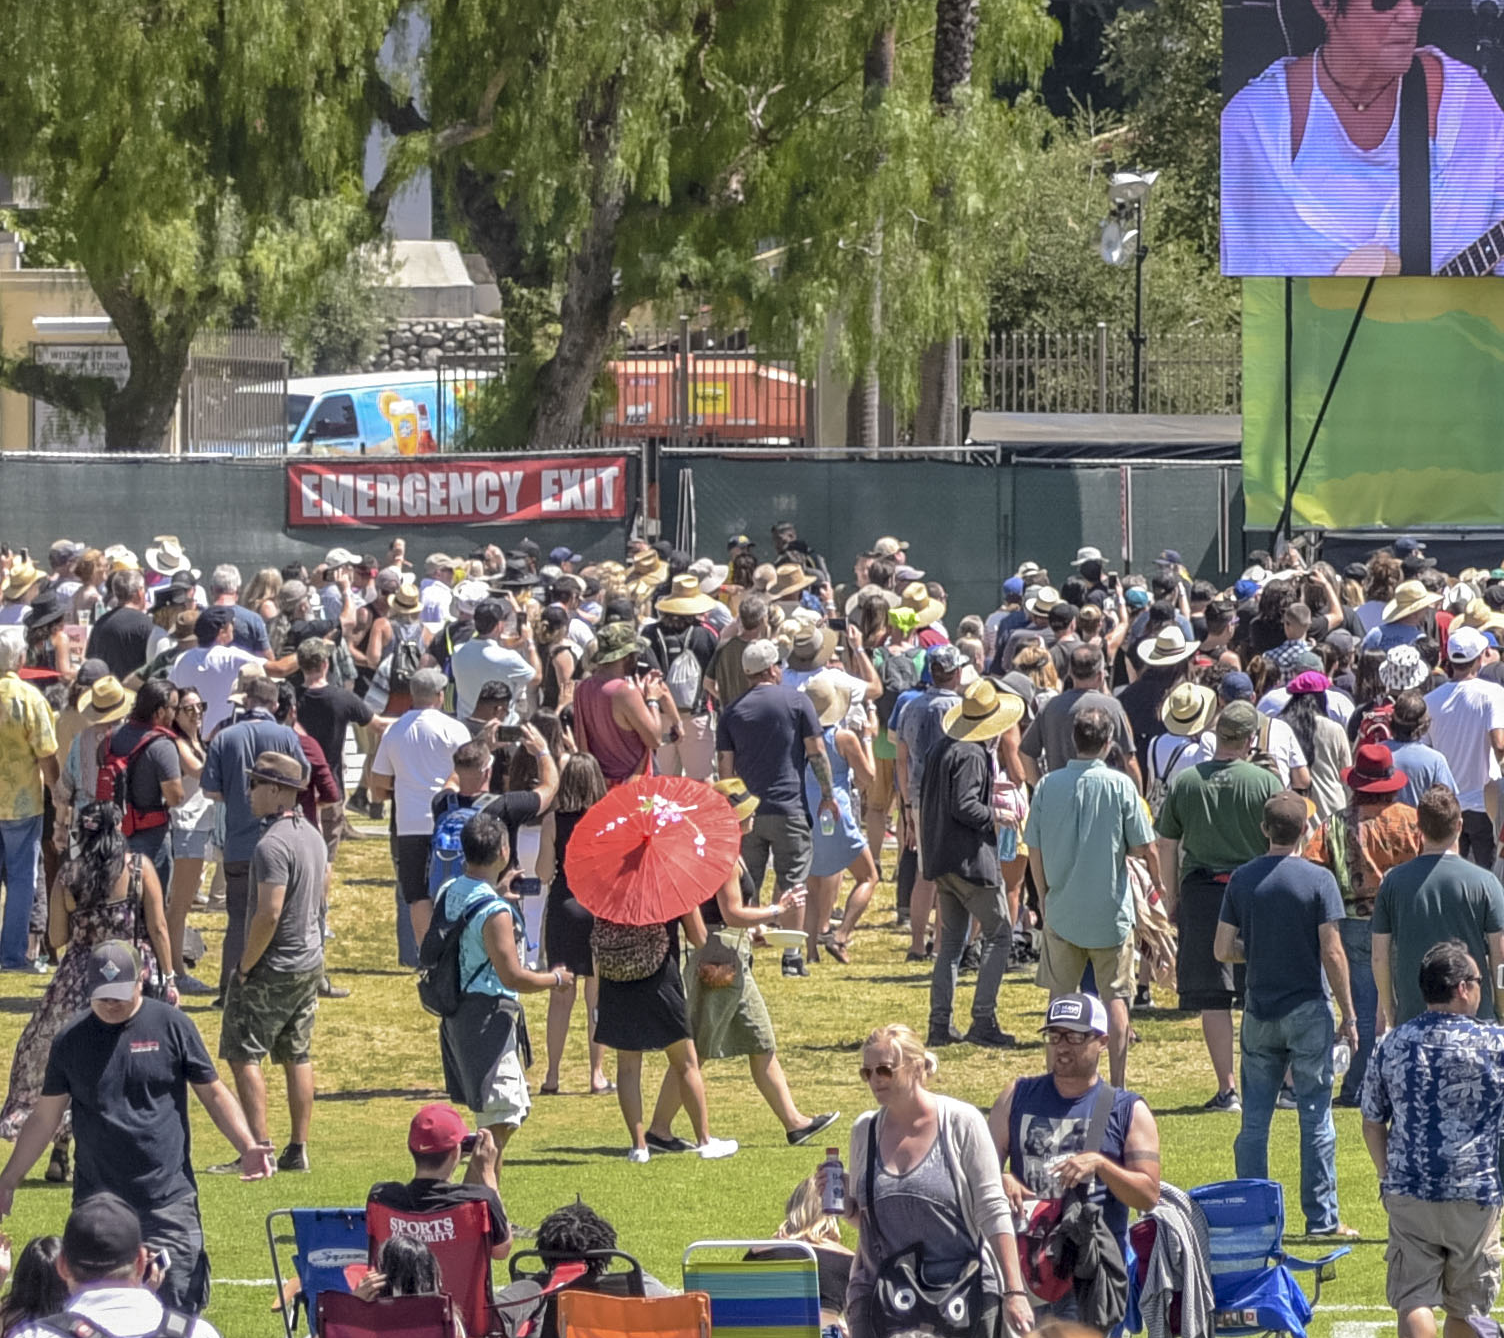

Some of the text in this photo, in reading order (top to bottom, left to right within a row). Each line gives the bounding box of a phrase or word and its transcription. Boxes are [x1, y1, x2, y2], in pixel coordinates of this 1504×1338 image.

[301, 464, 620, 518] EMERGENCY EXIT
[389, 1217, 455, 1236] SPORTS
